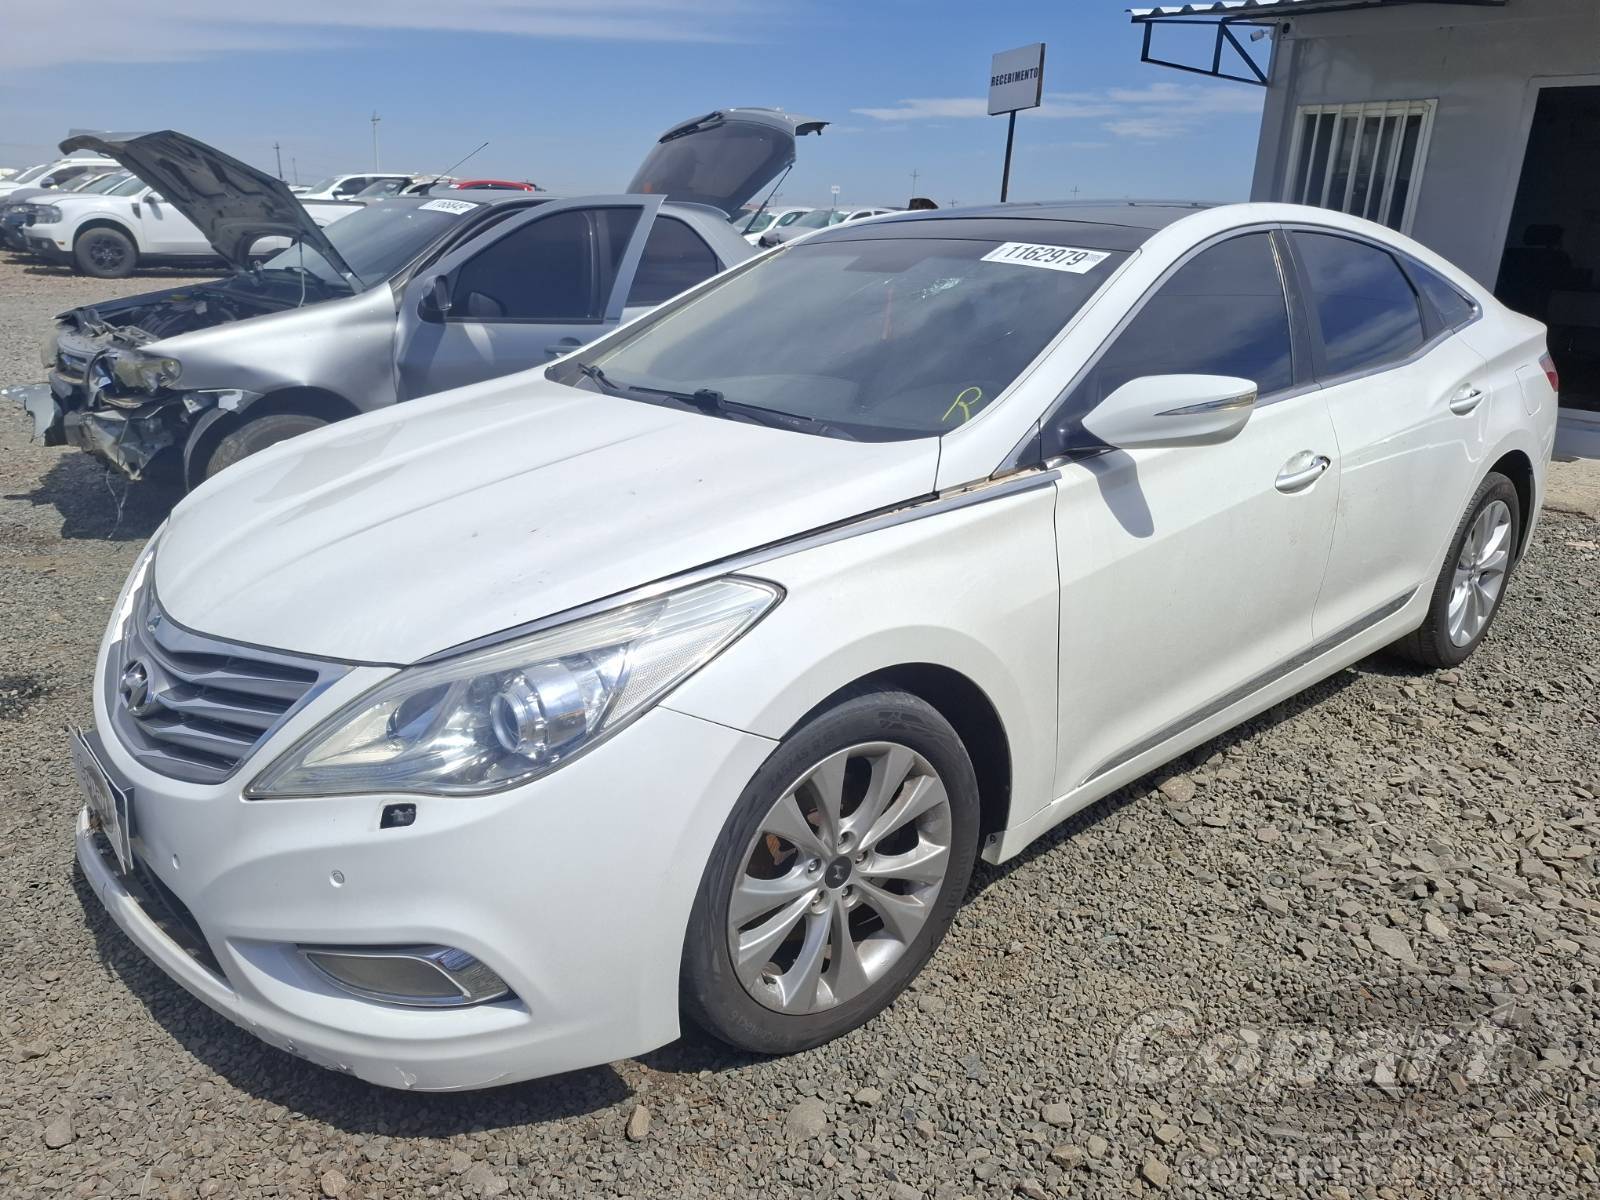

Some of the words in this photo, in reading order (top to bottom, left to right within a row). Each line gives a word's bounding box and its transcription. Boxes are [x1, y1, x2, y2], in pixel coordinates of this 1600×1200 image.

[990, 66, 1039, 87] RECEBIMENTO
[1004, 244, 1089, 266] 1162979
[941, 386, 982, 423] R
